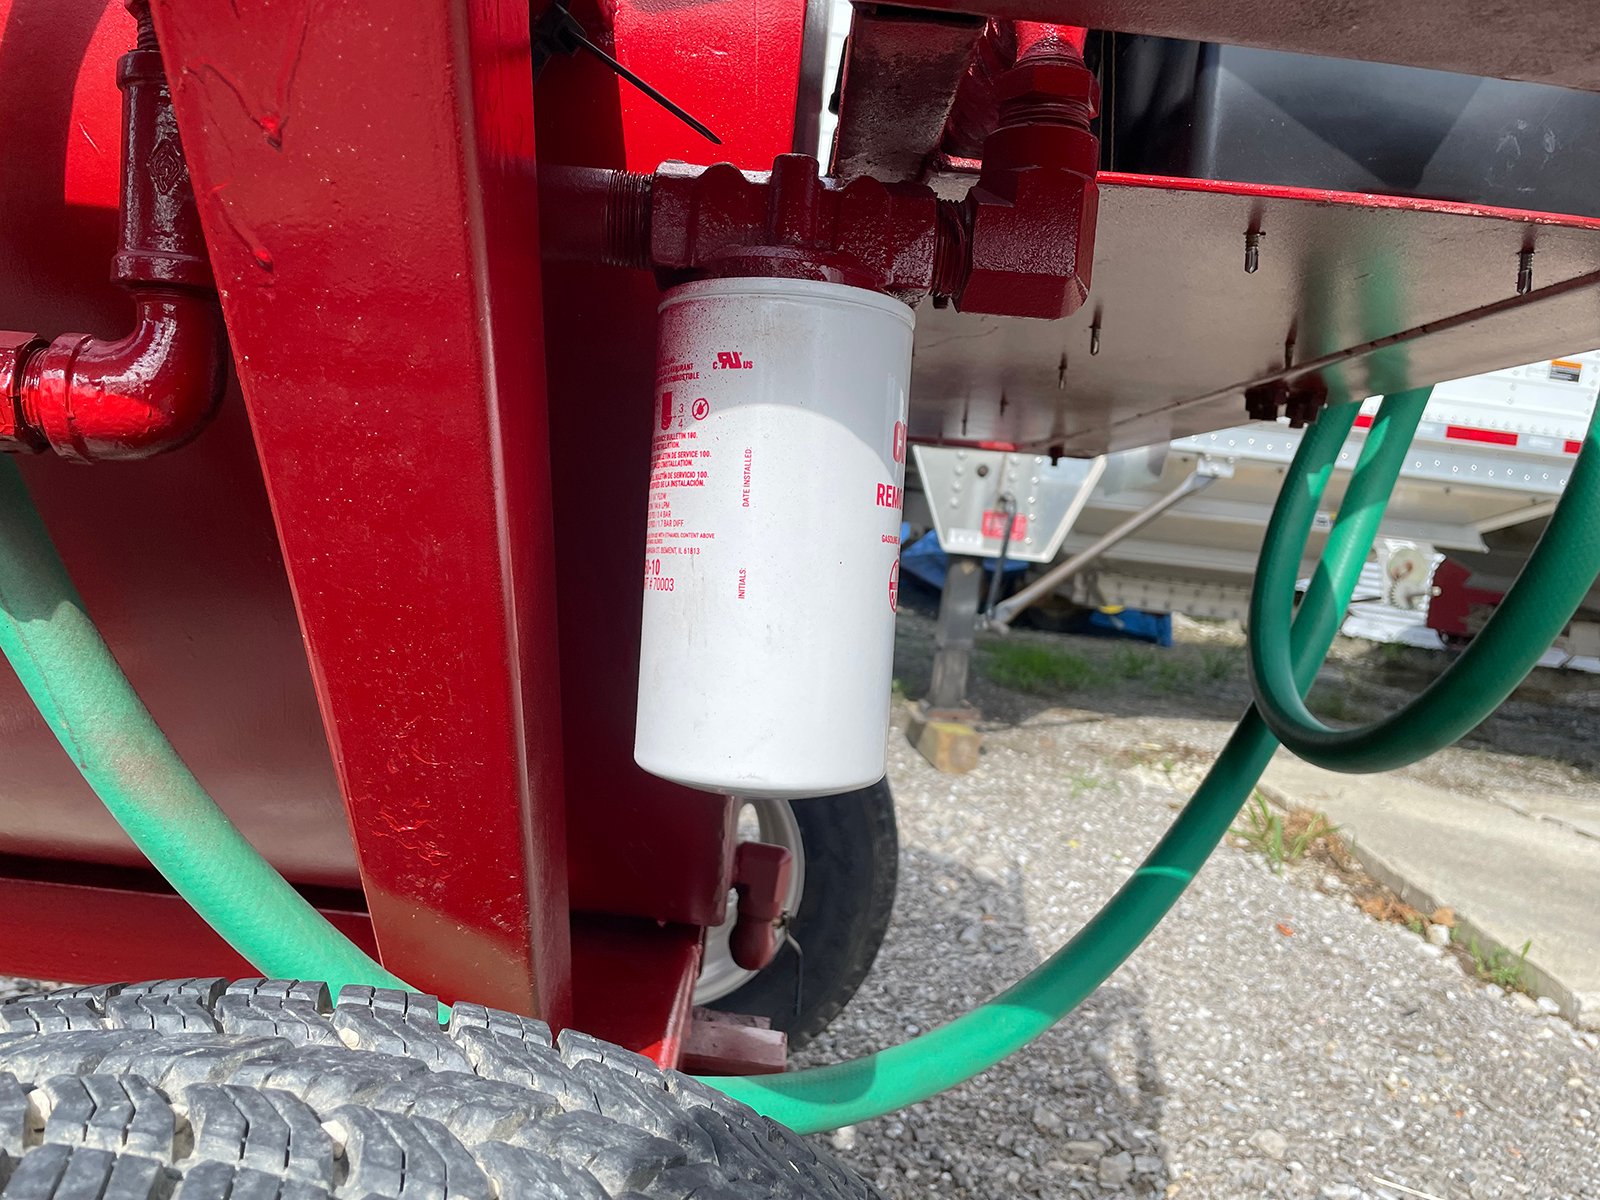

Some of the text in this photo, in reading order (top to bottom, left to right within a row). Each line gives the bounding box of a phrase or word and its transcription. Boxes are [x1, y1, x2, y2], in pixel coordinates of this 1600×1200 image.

[677, 450, 698, 458] SERVICE
[673, 471, 695, 479] SERVICIO
[742, 446, 752, 508] DATE INSTALLED:
[663, 520, 673, 528] BAR
[683, 547, 700, 555] 61813
[653, 577, 675, 592] 70003
[738, 567, 747, 600] INITIALS:
